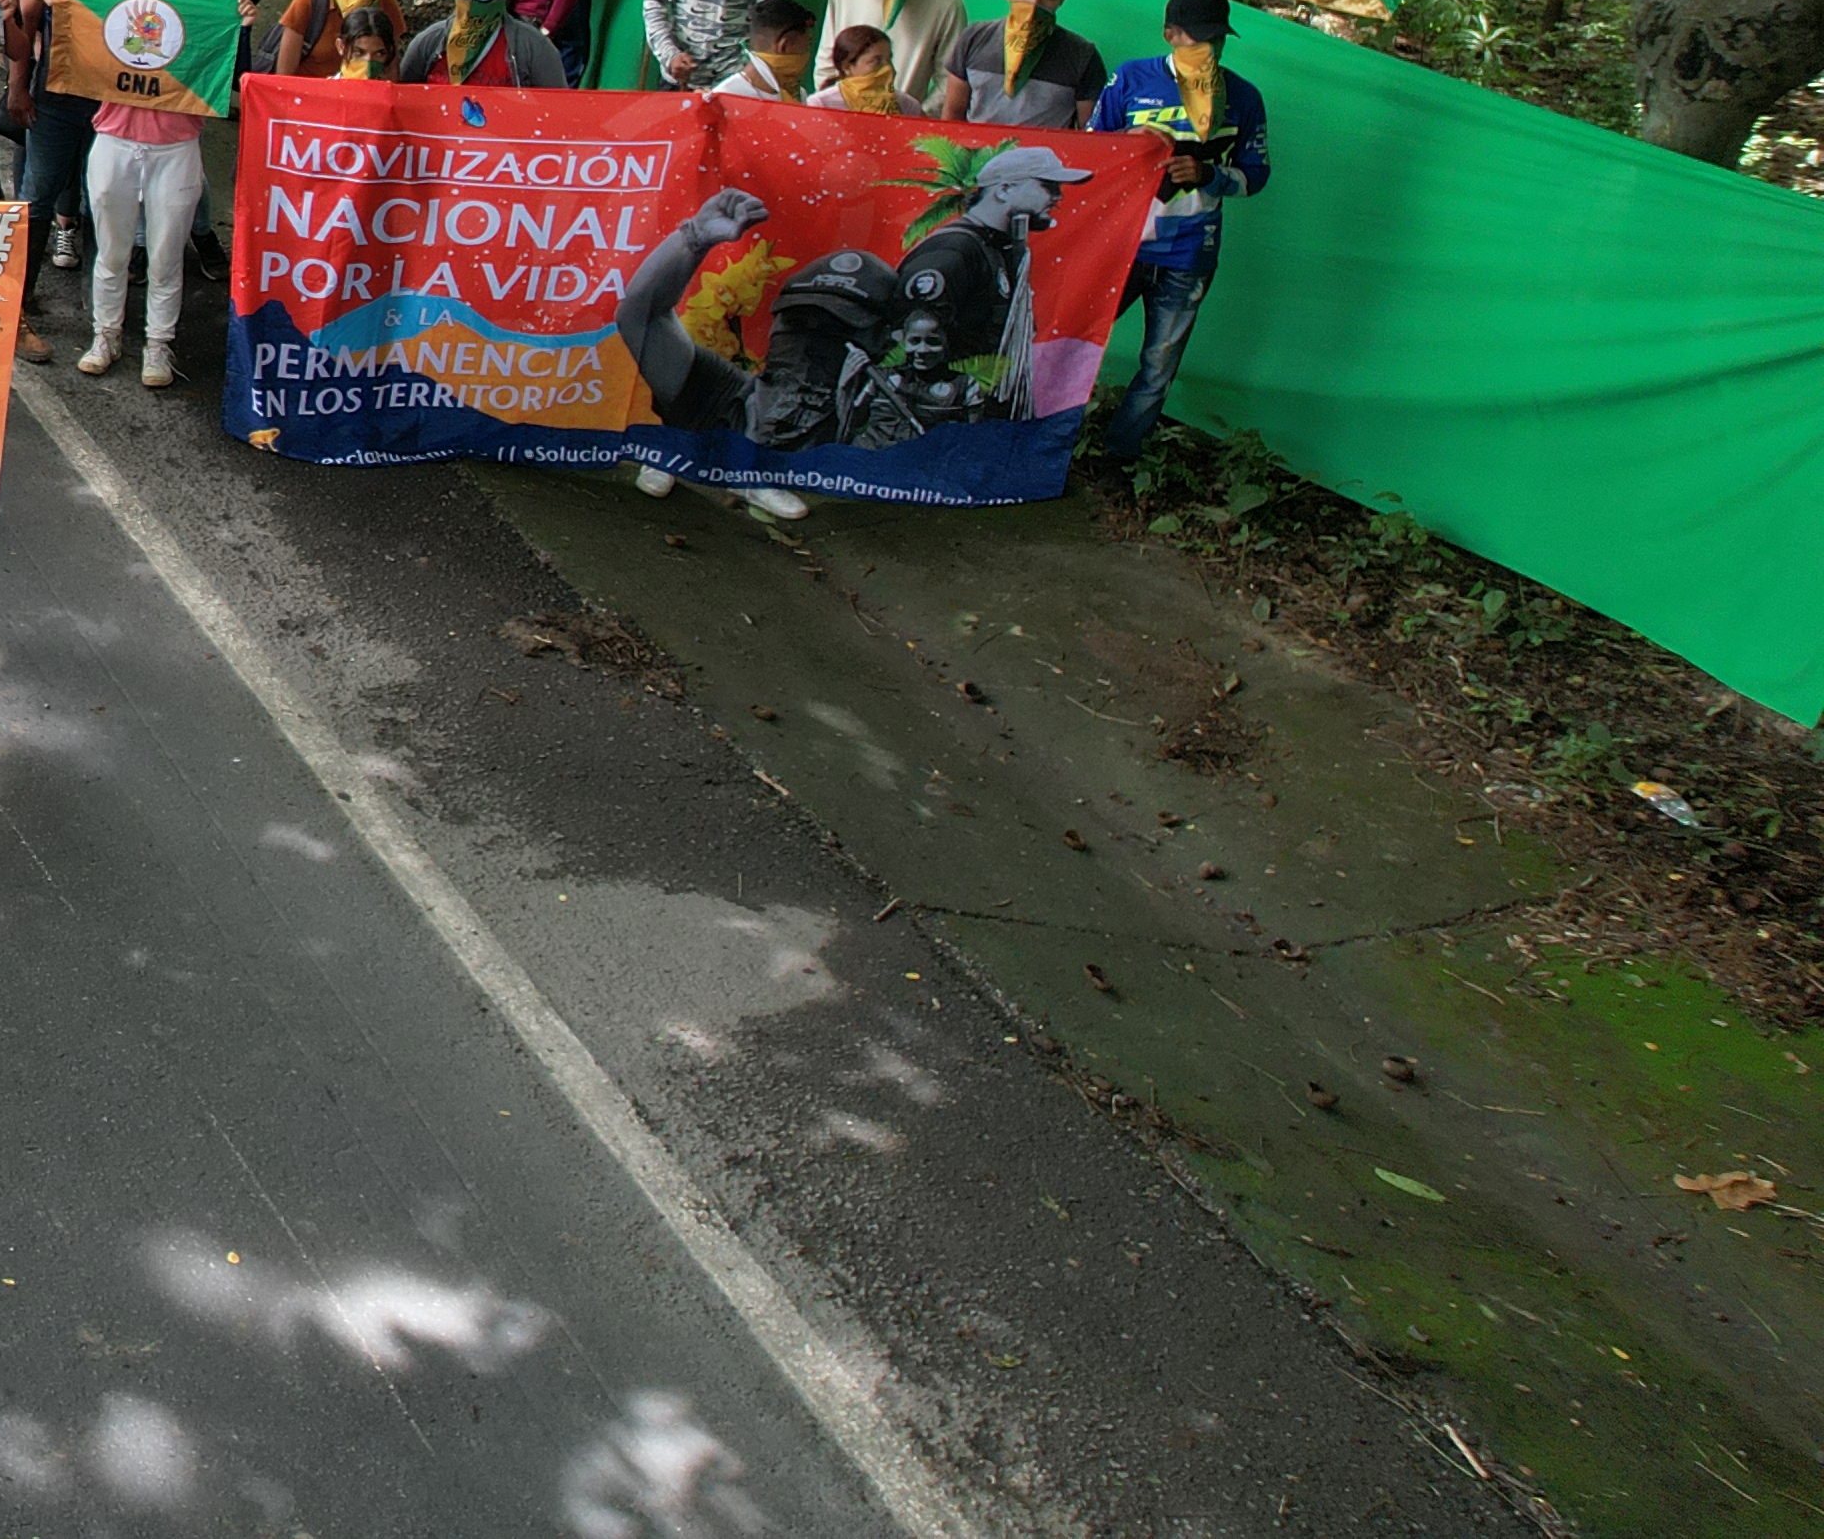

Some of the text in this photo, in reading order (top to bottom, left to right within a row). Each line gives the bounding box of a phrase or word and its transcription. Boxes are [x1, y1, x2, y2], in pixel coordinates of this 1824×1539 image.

[116, 71, 161, 98] CNA
[279, 135, 656, 187] MOVILIZACIÓN
[265, 185, 647, 253] NACIONAL
[259, 251, 627, 305] POR LA VIDA
[384, 309, 455, 328] & LA
[253, 342, 604, 381] PERMANENCIA
[252, 378, 604, 418] EN LOS TERRITORIOS
